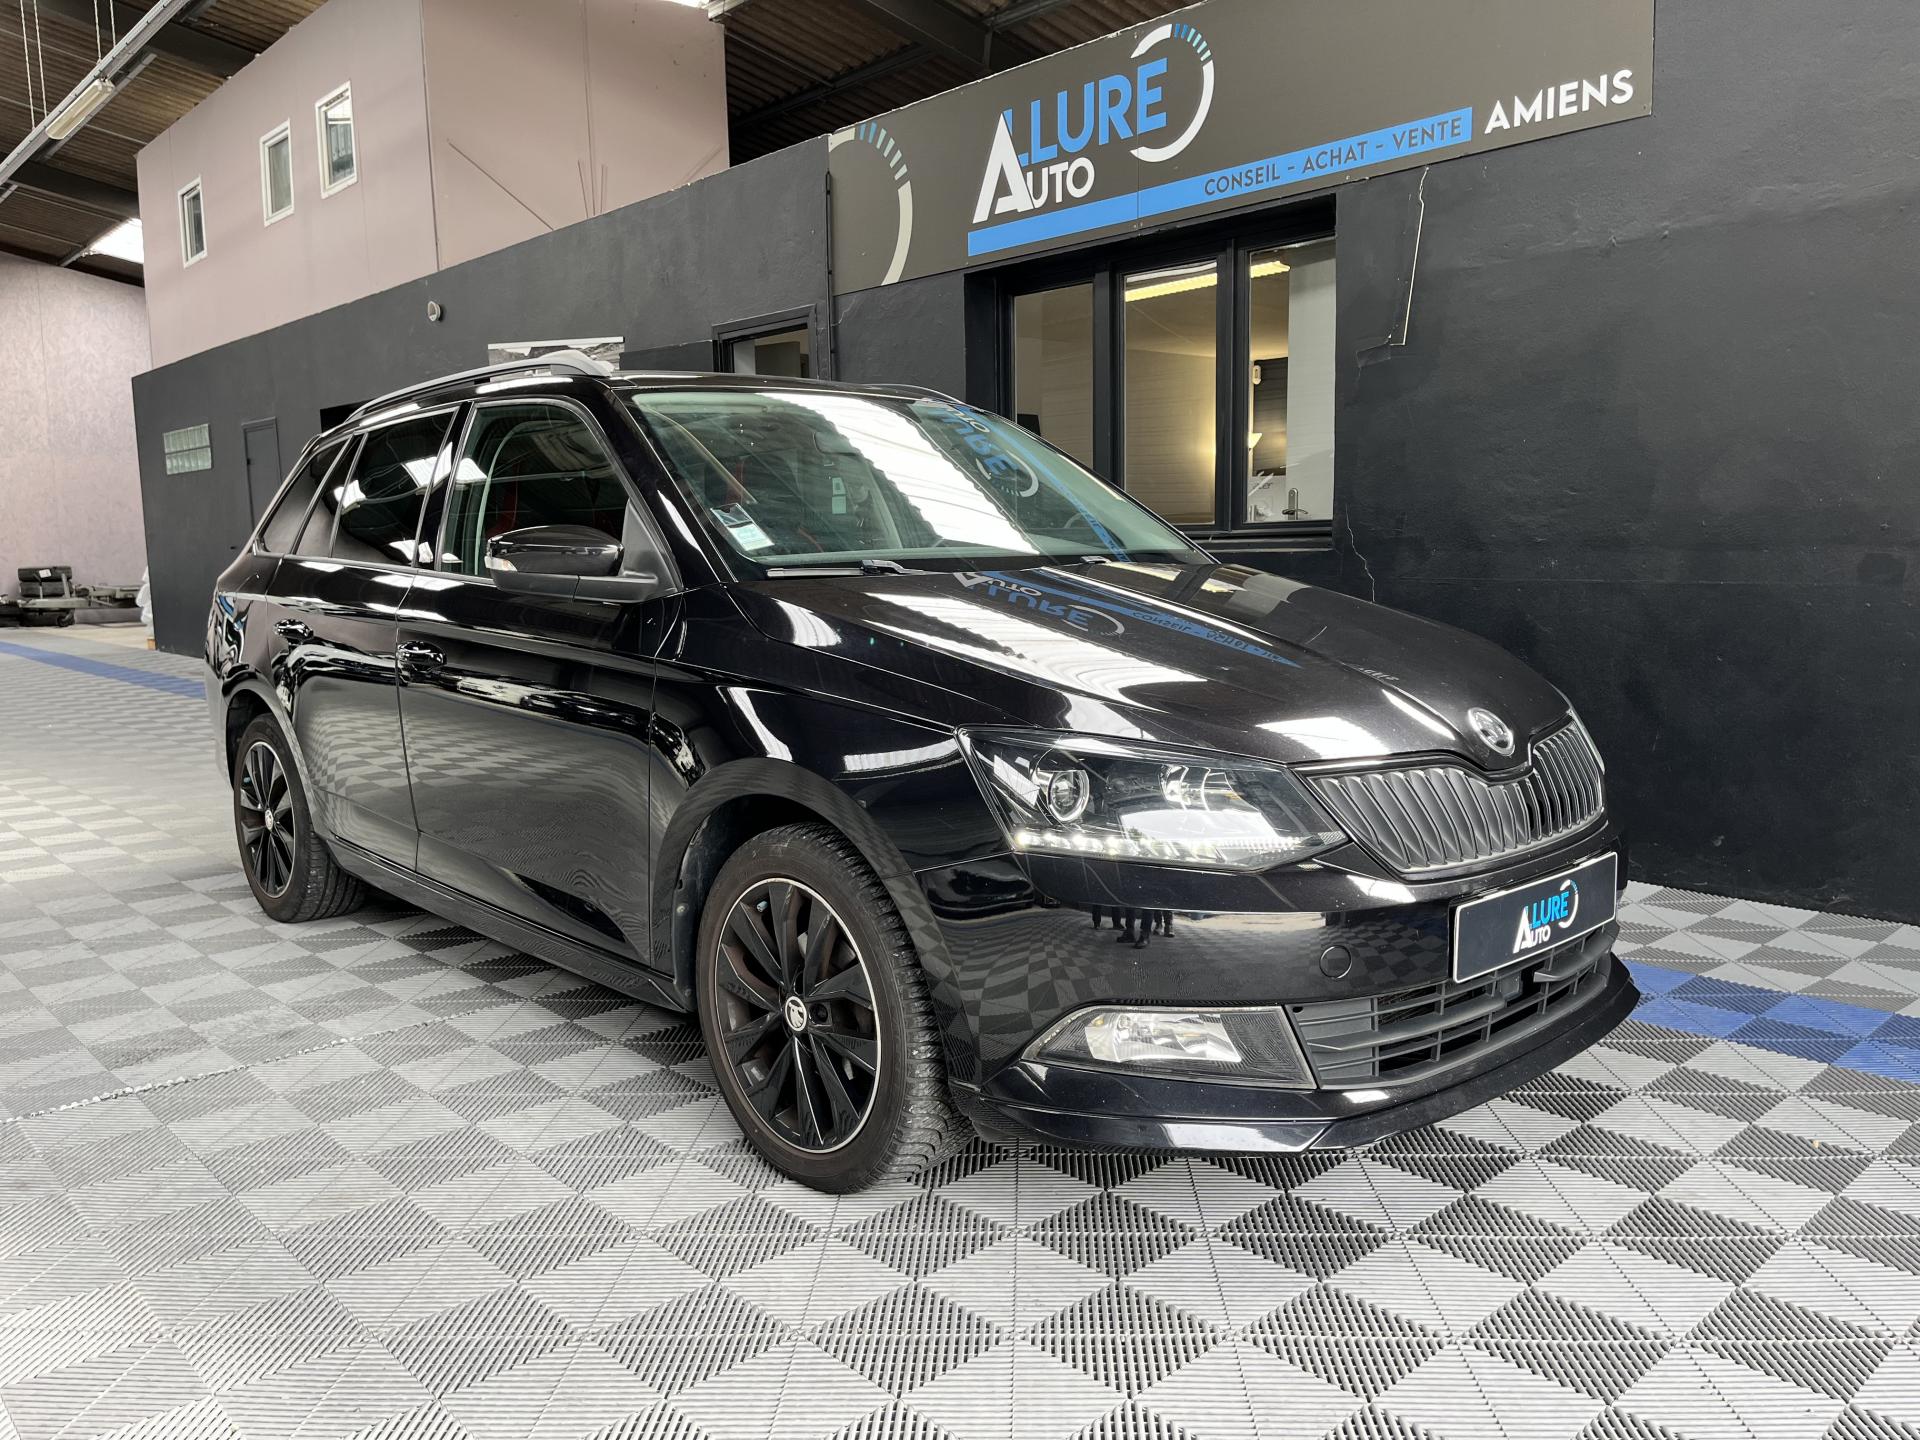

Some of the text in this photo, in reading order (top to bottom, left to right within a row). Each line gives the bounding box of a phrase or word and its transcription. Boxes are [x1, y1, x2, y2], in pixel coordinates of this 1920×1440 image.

[1484, 69, 1634, 134] AMIENS
[973, 113, 1095, 224] AUTO
[1204, 162, 1281, 196] CONSEIL
[1302, 141, 1369, 174] ACHAT
[1392, 117, 1462, 151] VENTE
[1513, 906, 1551, 953] AUTO
